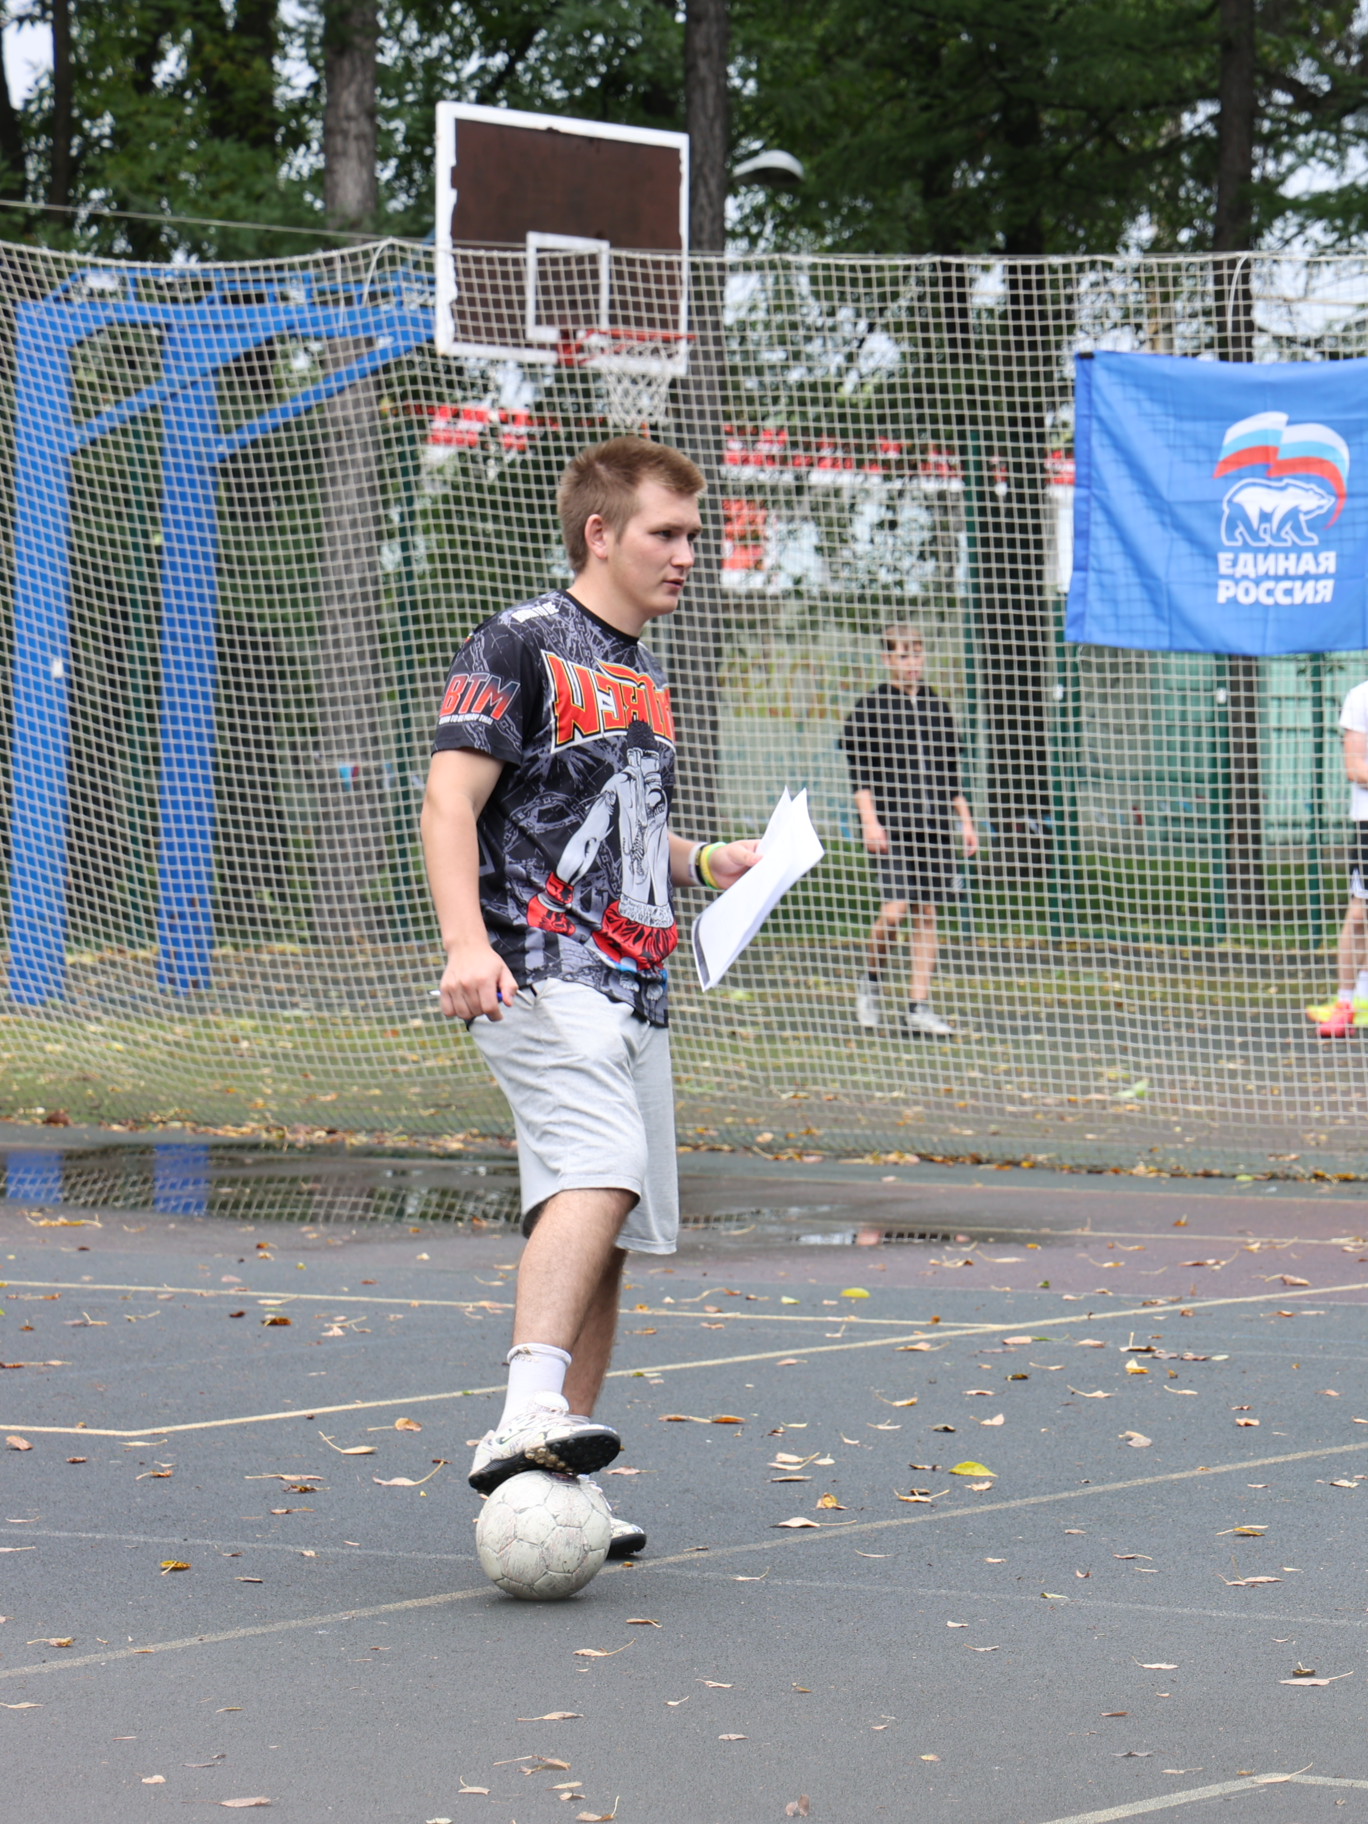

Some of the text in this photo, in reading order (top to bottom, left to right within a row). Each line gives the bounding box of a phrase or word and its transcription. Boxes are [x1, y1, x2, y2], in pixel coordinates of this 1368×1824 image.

[1217, 551, 1337, 578] ЕДИНАЯ
[1217, 579, 1335, 606] РОССИЯ
[439, 672, 520, 720] BTM
